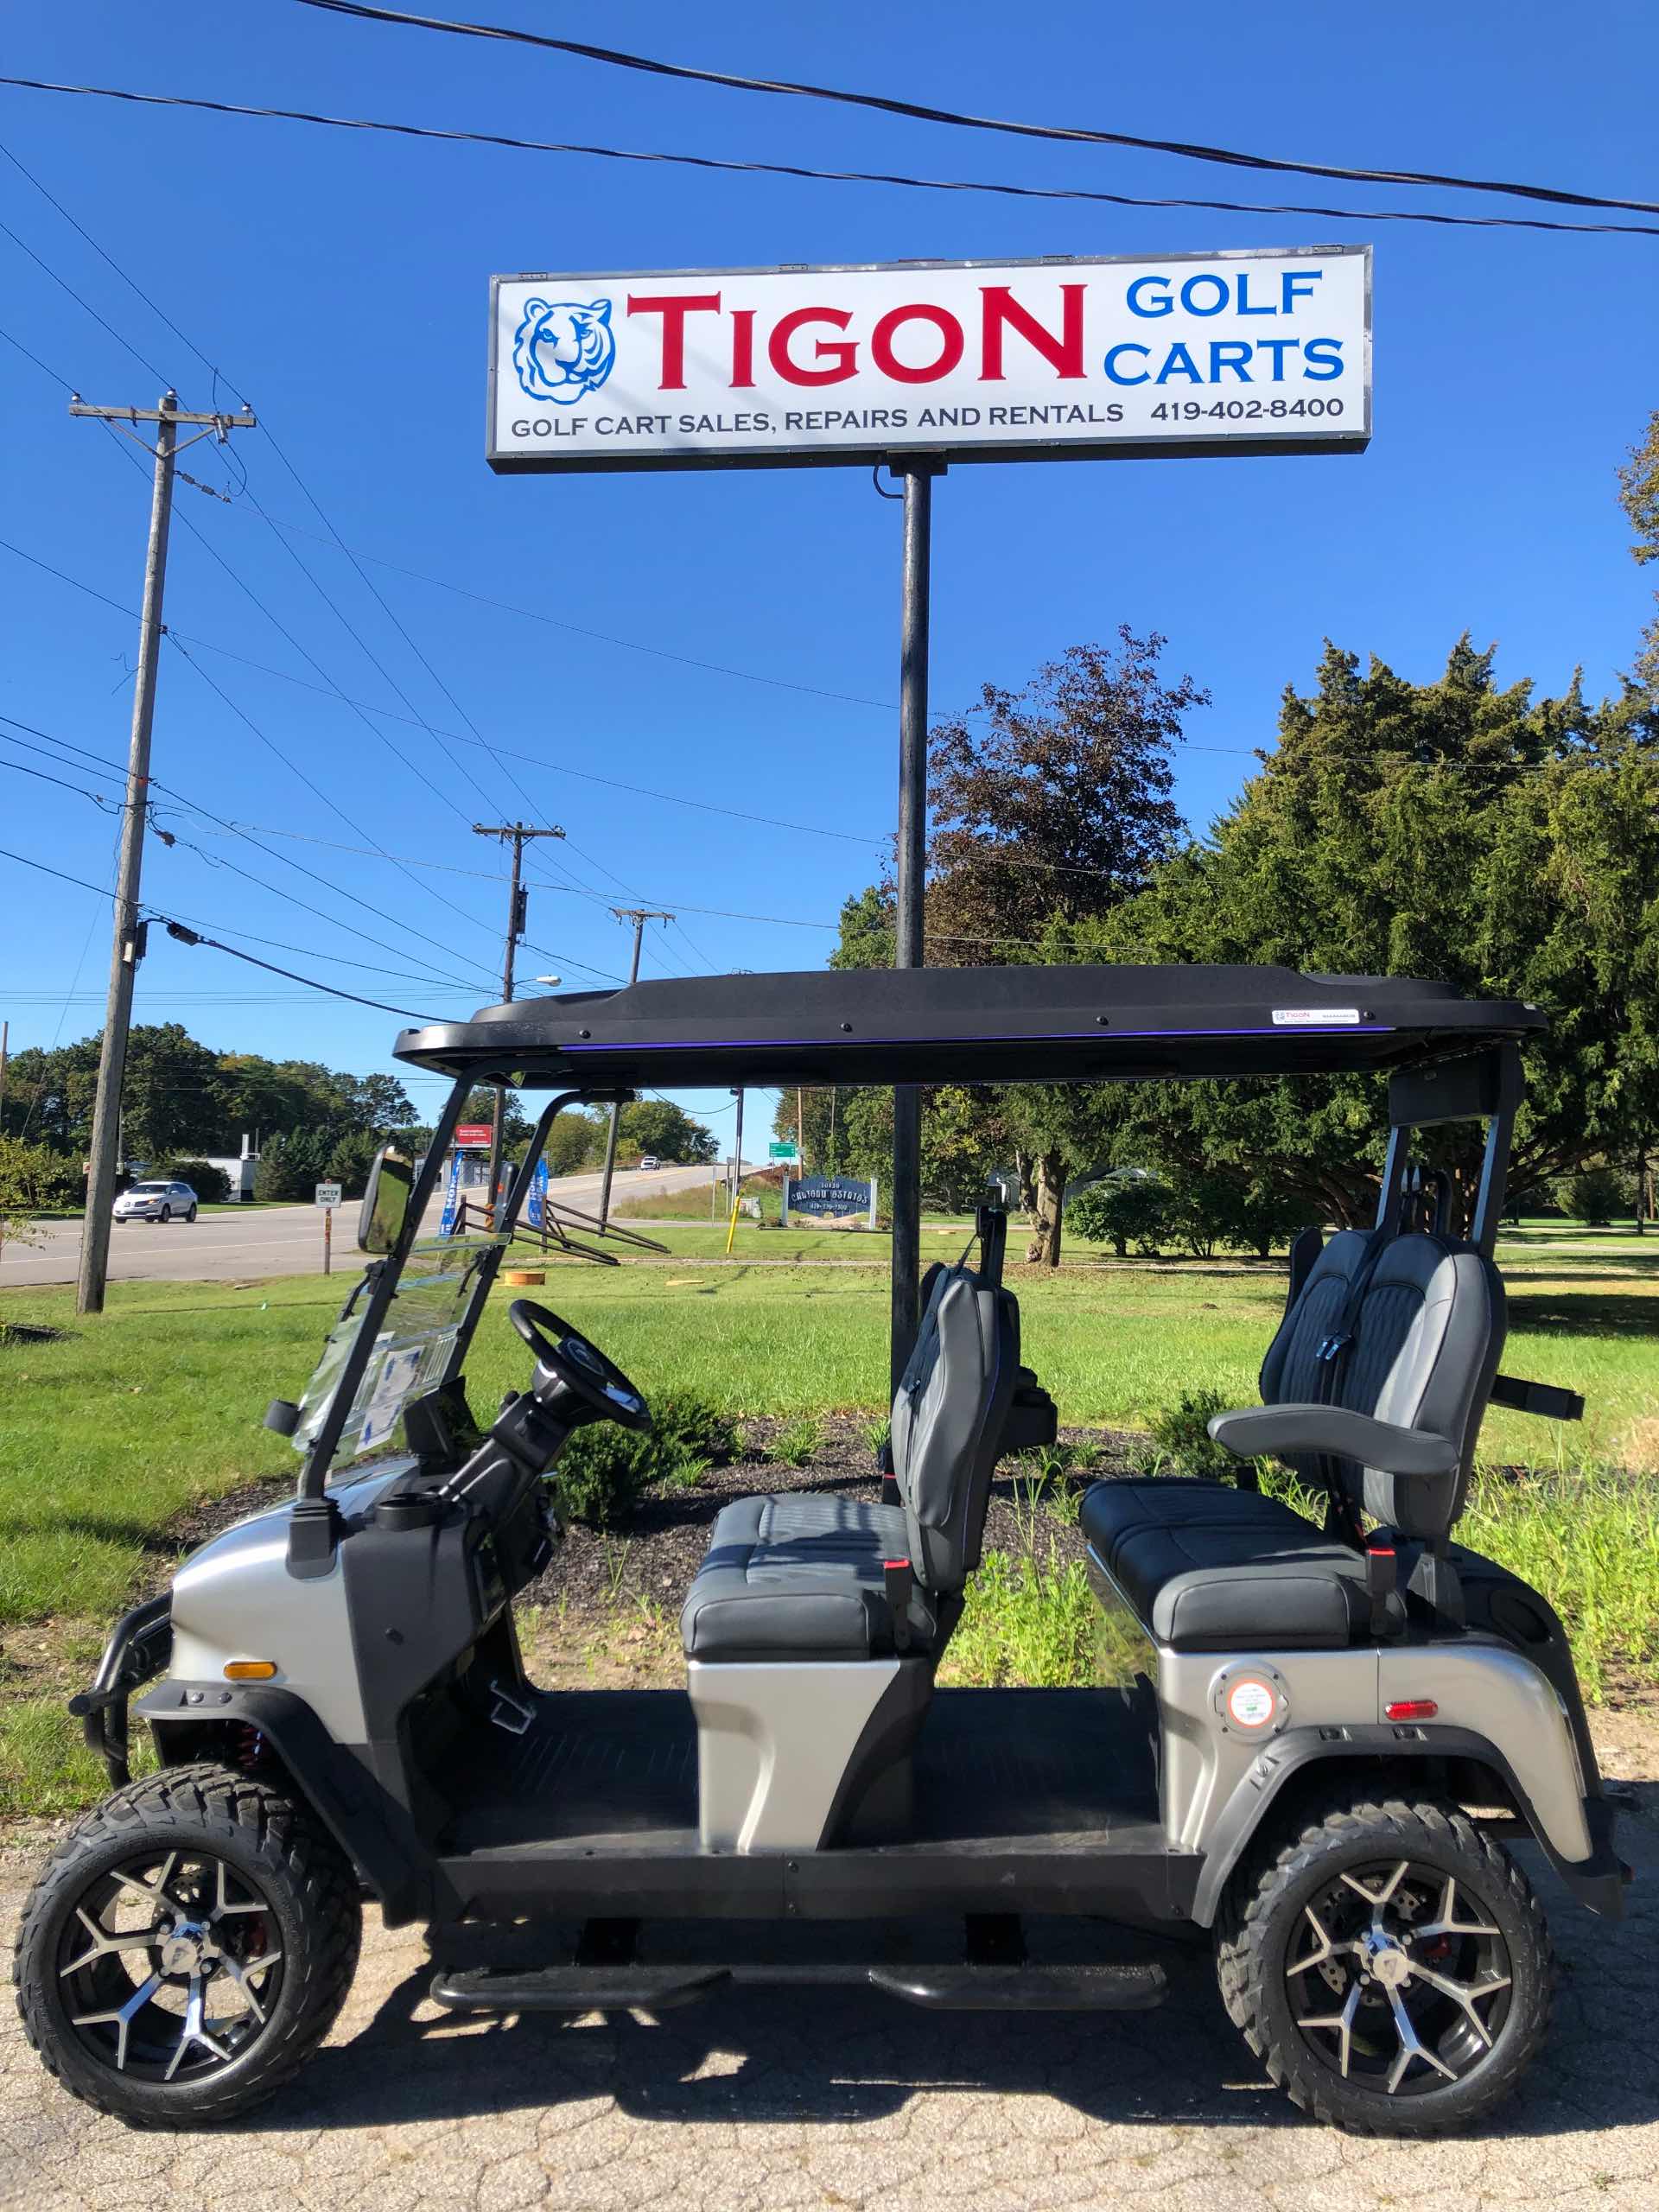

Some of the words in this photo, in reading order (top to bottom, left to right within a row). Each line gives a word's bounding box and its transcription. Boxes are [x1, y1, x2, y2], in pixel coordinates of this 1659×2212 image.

[1126, 270, 1323, 318] GOLF
[627, 284, 1088, 390] TIGON
[1103, 337, 1344, 386] CARTS
[512, 417, 588, 437] GOLF
[594, 415, 672, 435] CART
[678, 412, 777, 435] SALES,
[785, 409, 908, 430] REPAIRS
[917, 407, 981, 428] AND
[988, 404, 1124, 425] RENTALS
[1150, 397, 1344, 421] 419-402-8400
